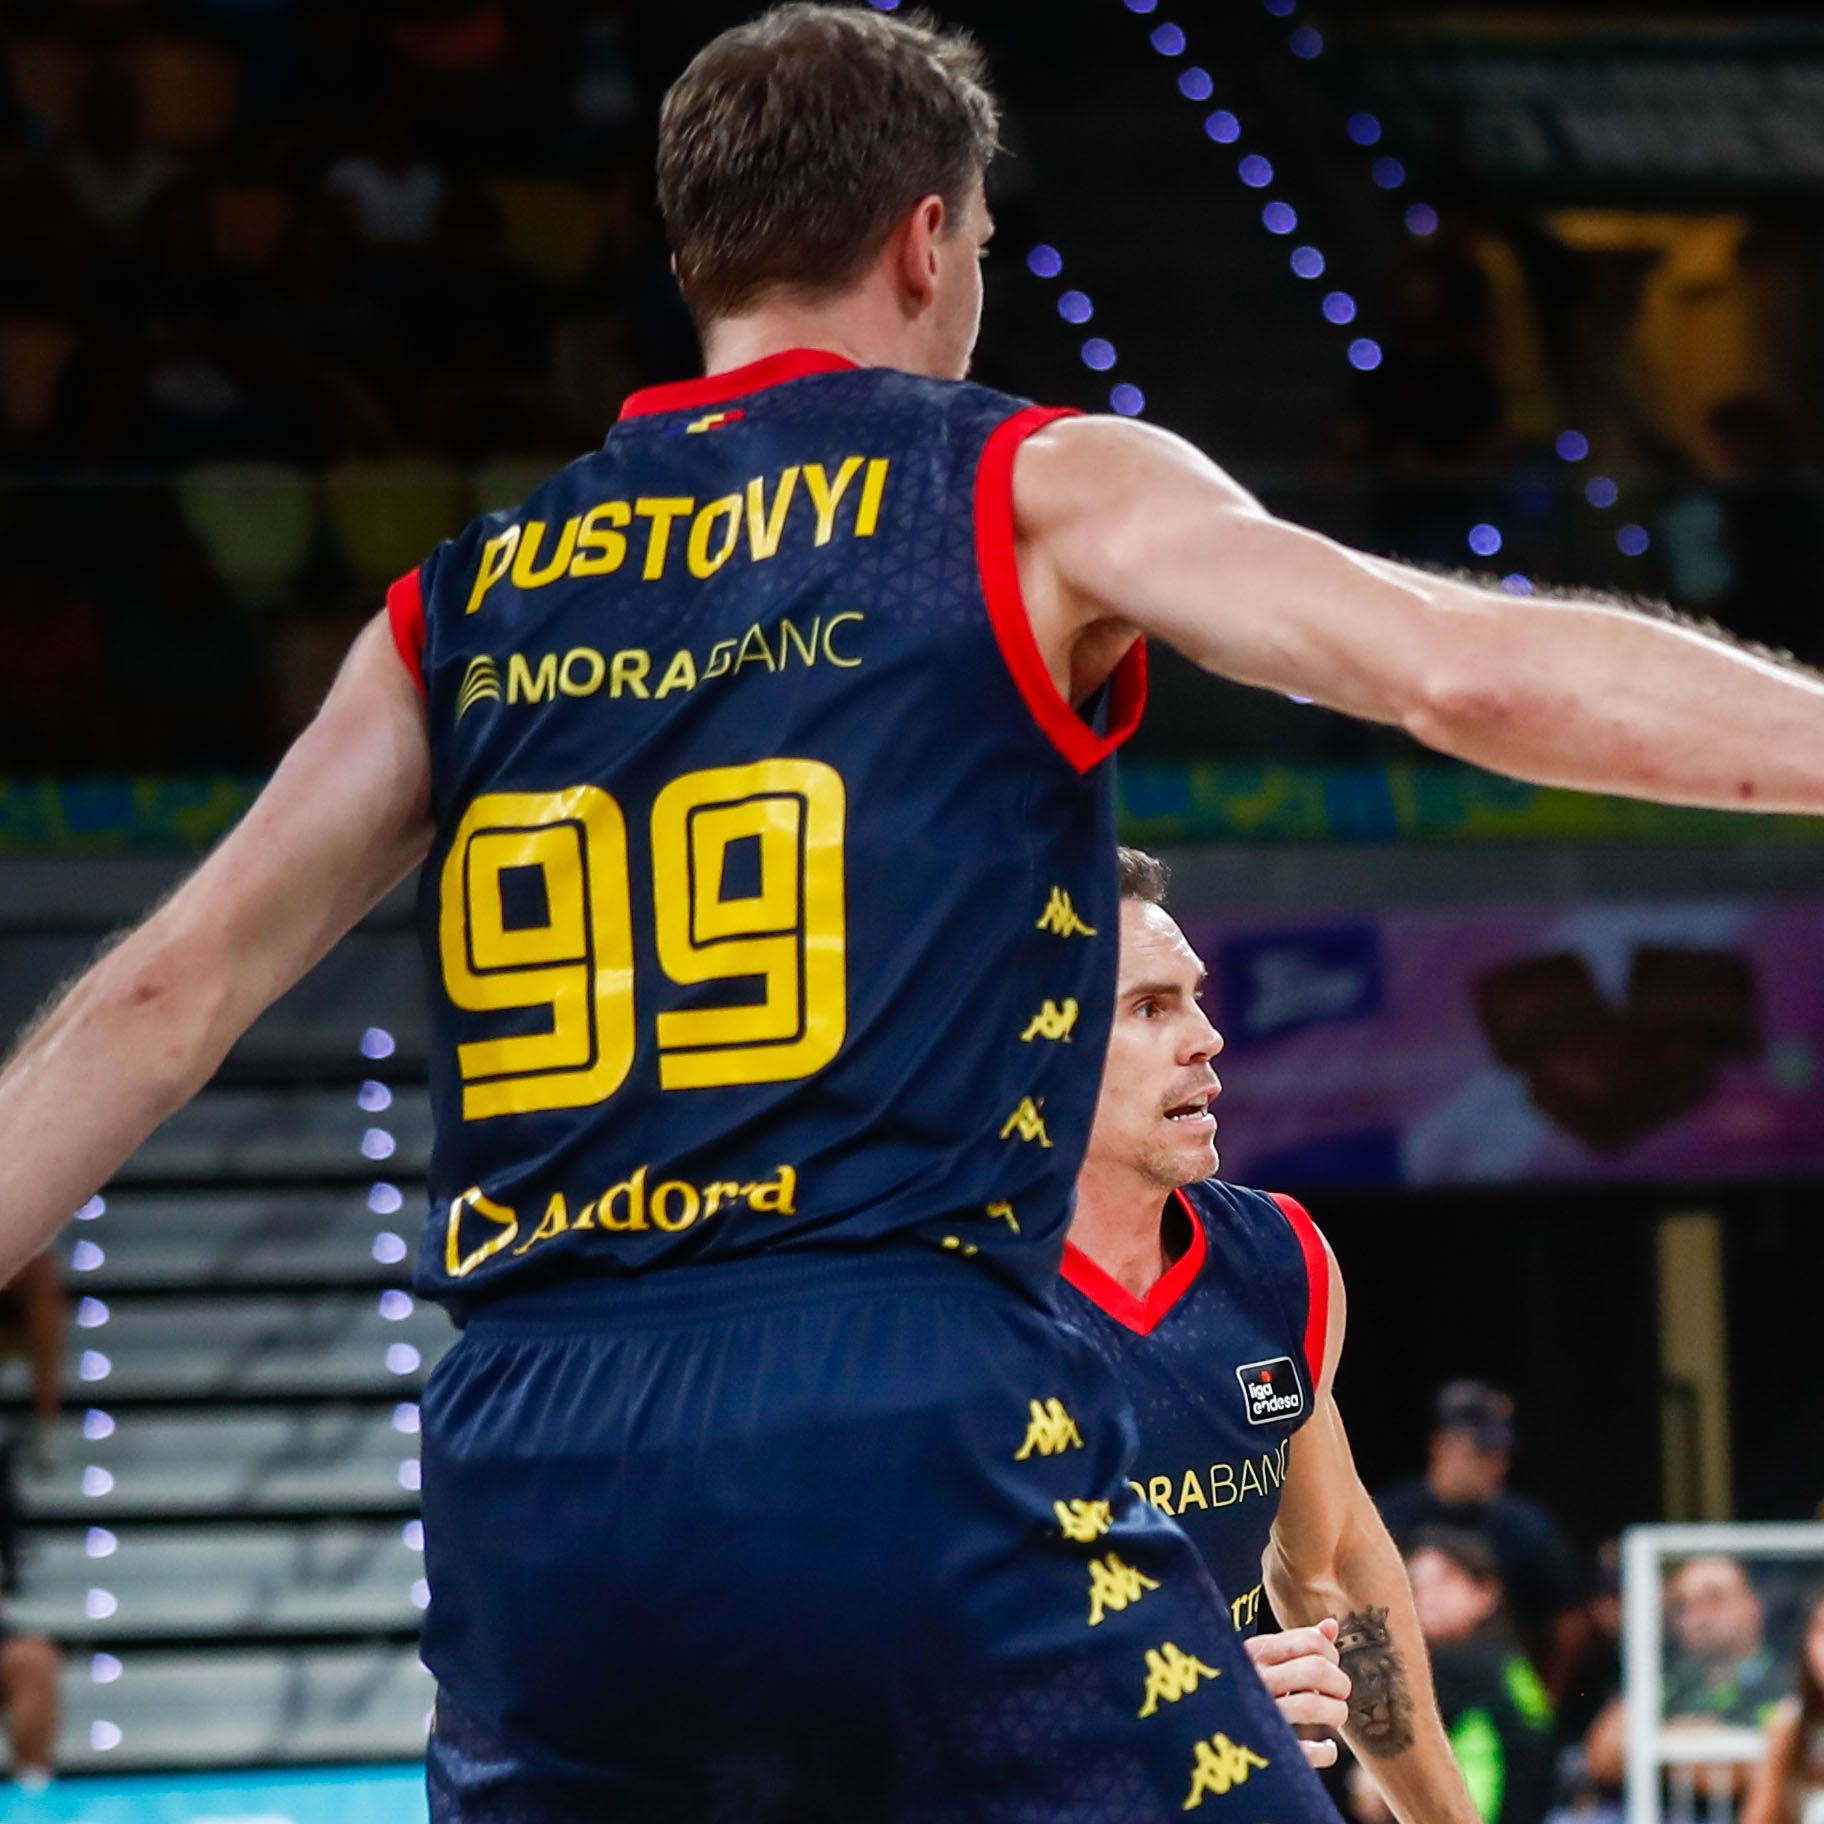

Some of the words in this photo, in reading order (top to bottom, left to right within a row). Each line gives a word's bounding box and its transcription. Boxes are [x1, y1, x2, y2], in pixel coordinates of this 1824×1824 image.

[465, 456, 889, 614] PUSTOVYI
[440, 757, 847, 1121] 99
[1248, 1382, 1273, 1400] liga
[1252, 1394, 1300, 1415] endesa
